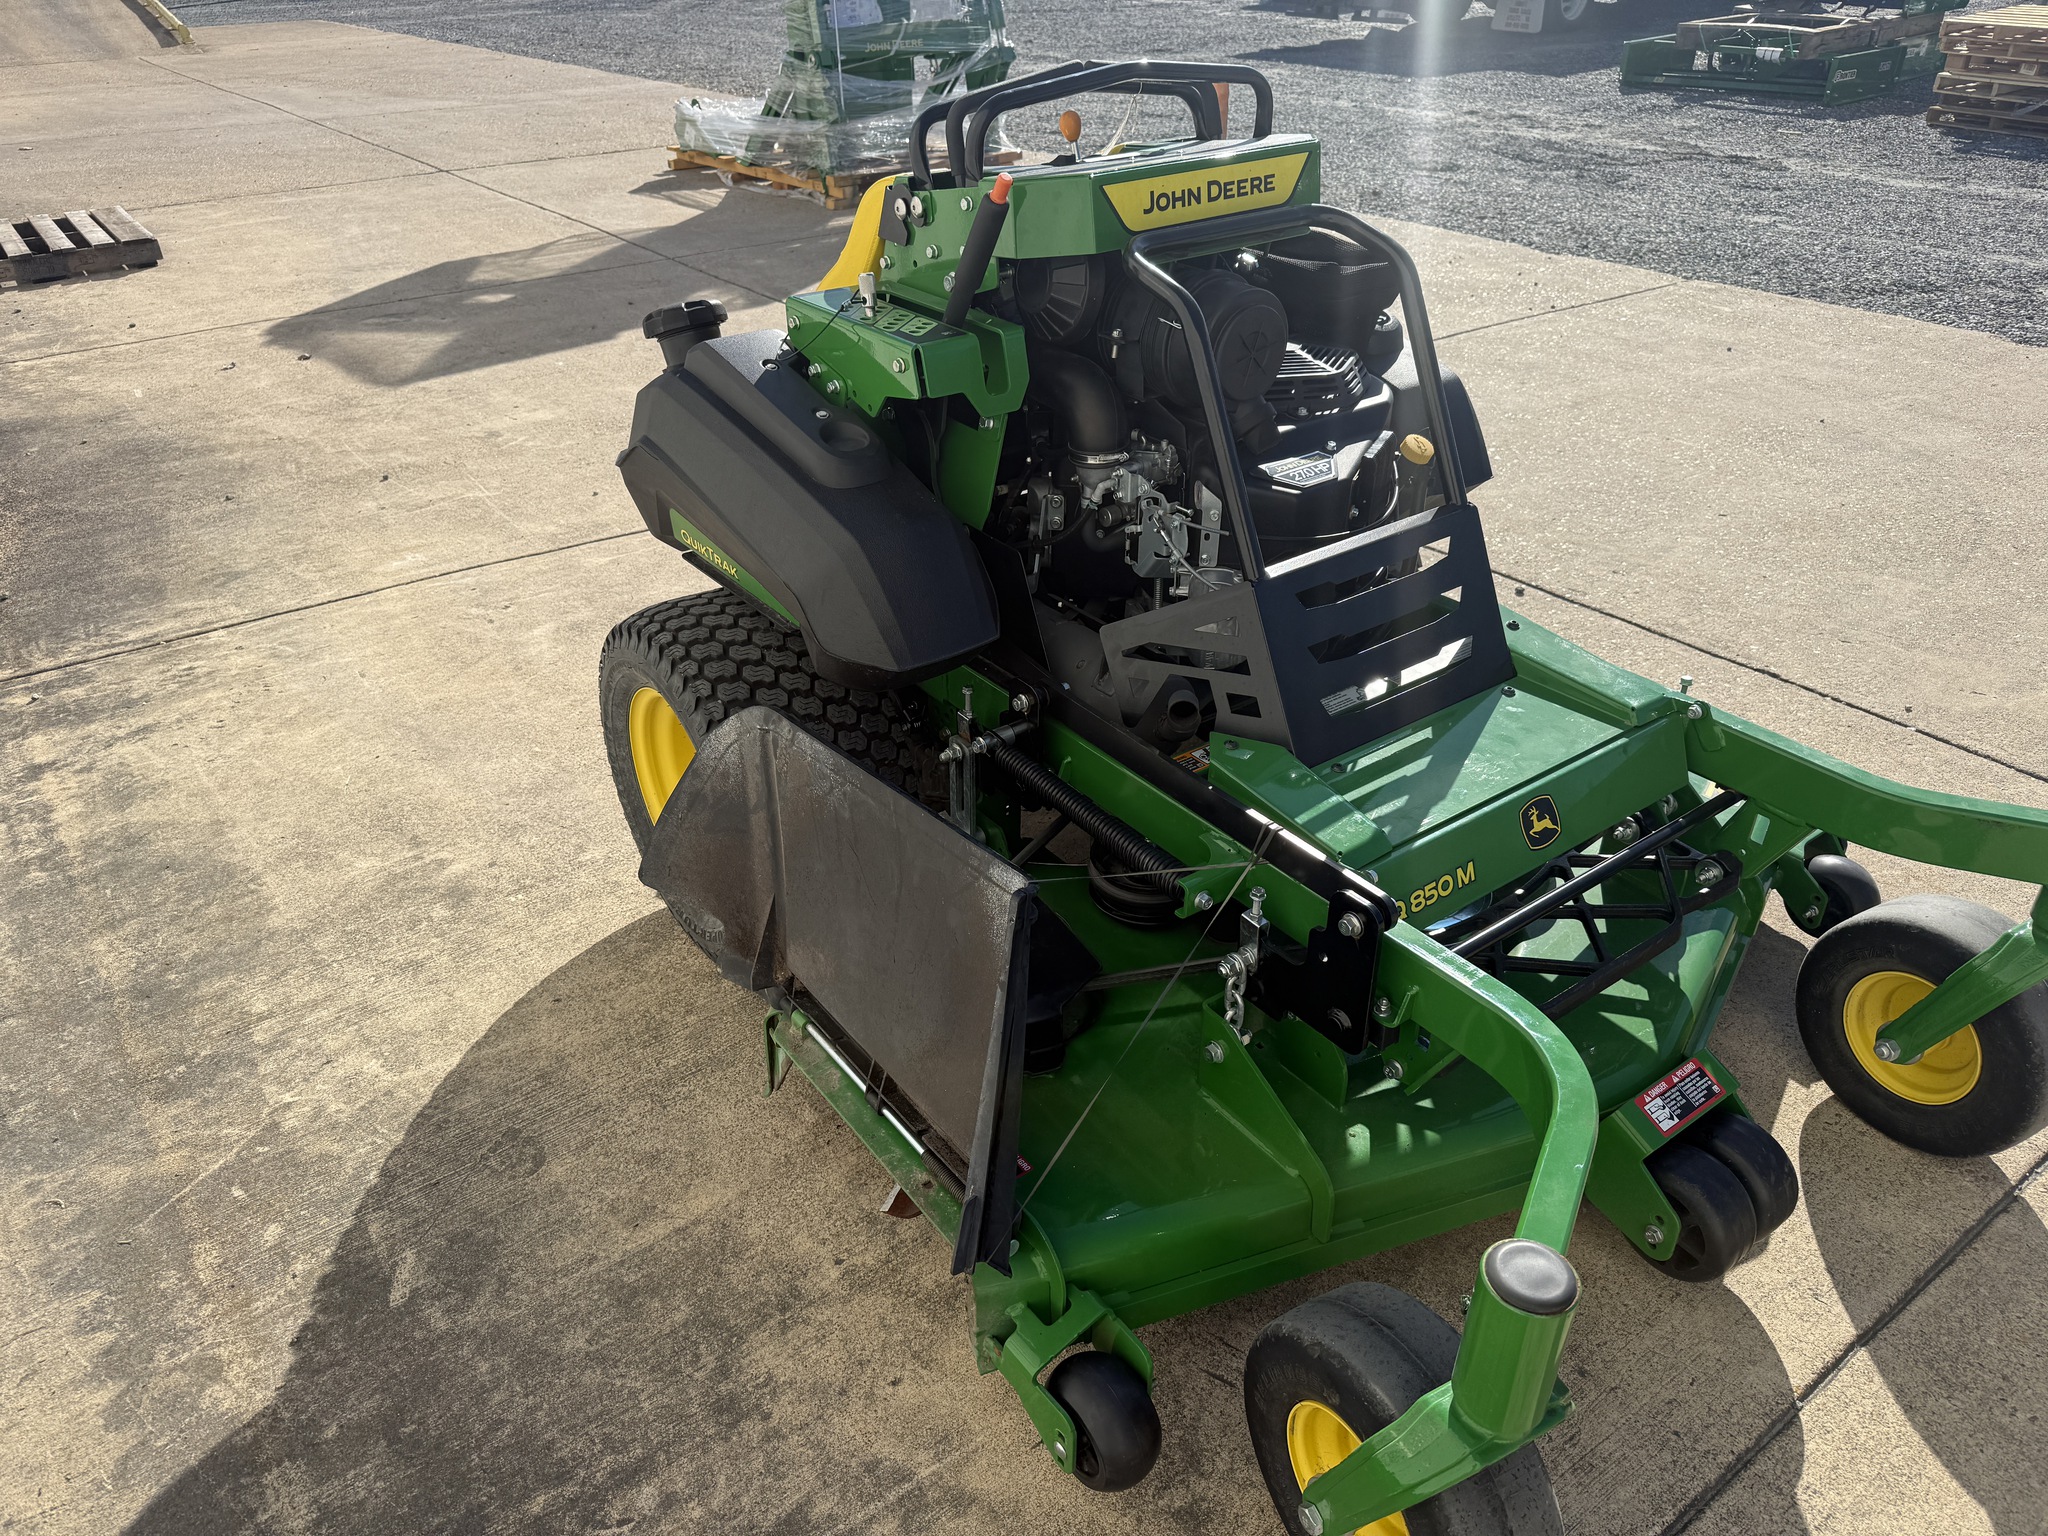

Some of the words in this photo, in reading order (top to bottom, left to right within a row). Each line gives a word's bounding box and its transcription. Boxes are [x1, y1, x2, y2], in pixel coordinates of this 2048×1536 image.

[865, 41, 891, 53] JOHN
[1143, 186, 1202, 215] JOHN
[1207, 173, 1276, 203] DEERE
[1274, 462, 1297, 473] JOHN
[1289, 467, 1315, 481] 27.0
[1310, 462, 1330, 474] HP
[1409, 874, 1455, 913] 850
[1456, 860, 1476, 889] M
